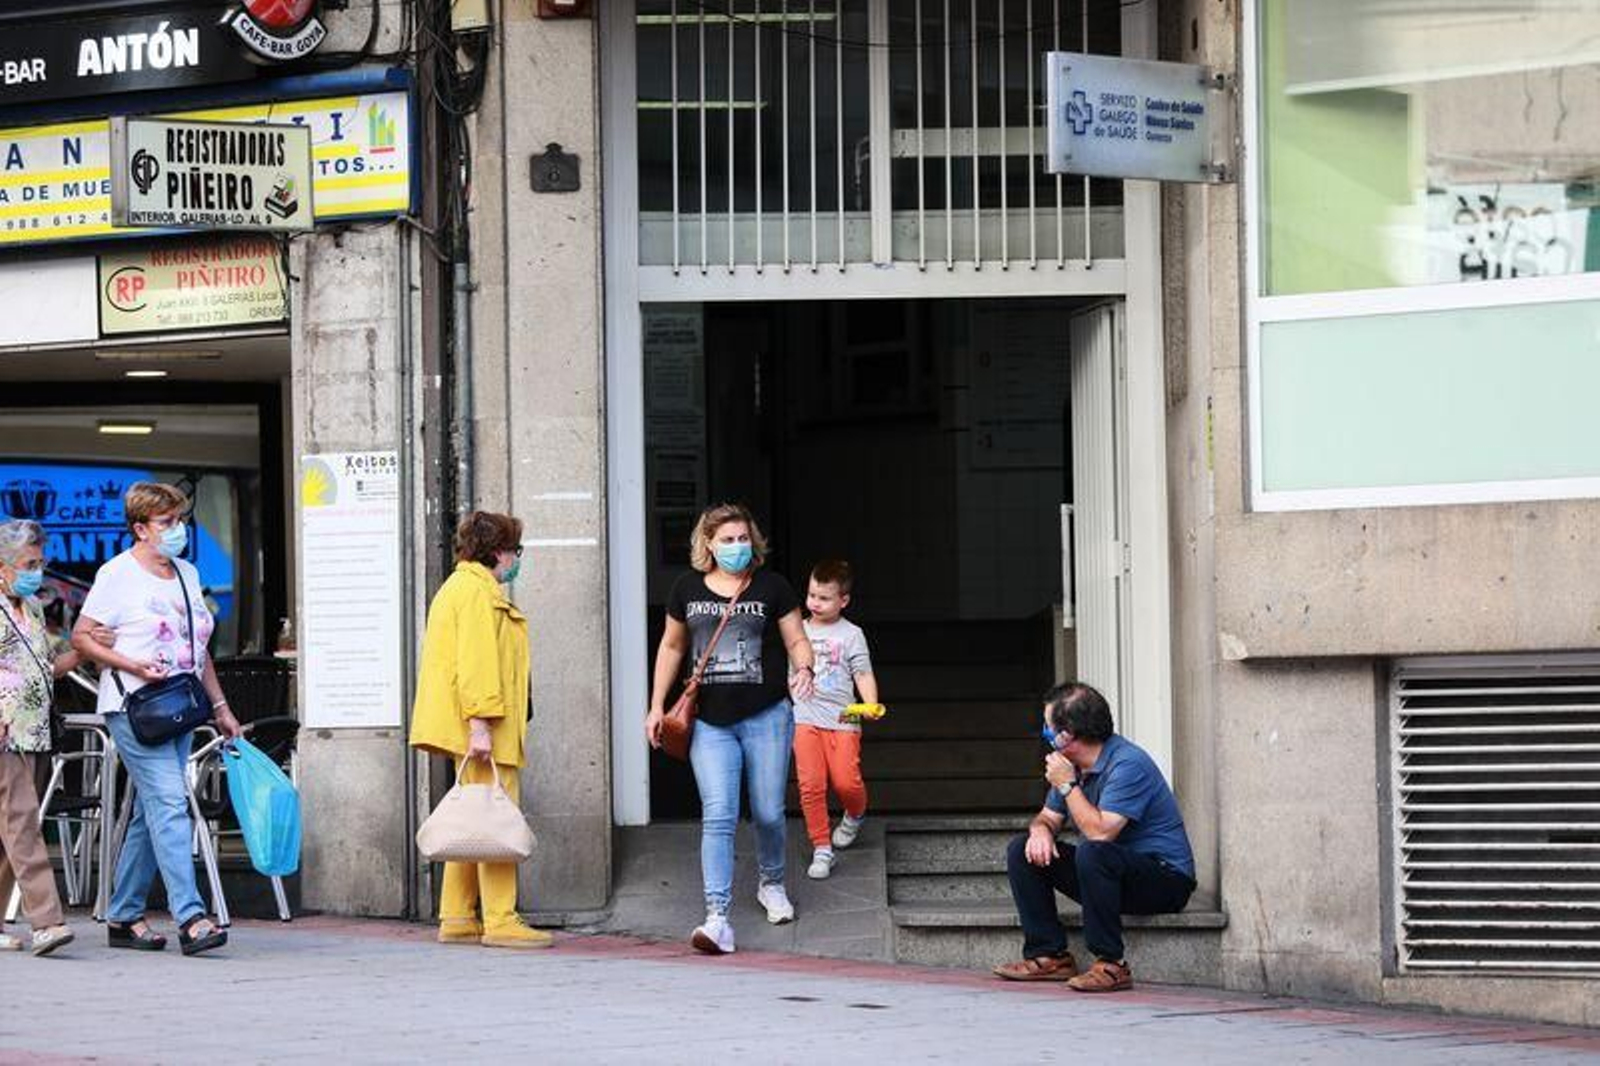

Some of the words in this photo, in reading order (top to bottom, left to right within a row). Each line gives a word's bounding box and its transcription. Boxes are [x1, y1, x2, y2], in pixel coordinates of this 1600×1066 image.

[77, 21, 199, 77] ANTÓN
[1100, 109, 1138, 125] GALEGO
[166, 128, 285, 166] REGISTRADORAS
[23, 185, 49, 202] DE
[62, 179, 112, 198] MUE
[167, 167, 253, 210] PIÑEIRO
[176, 264, 266, 292] PIÑEIRO
